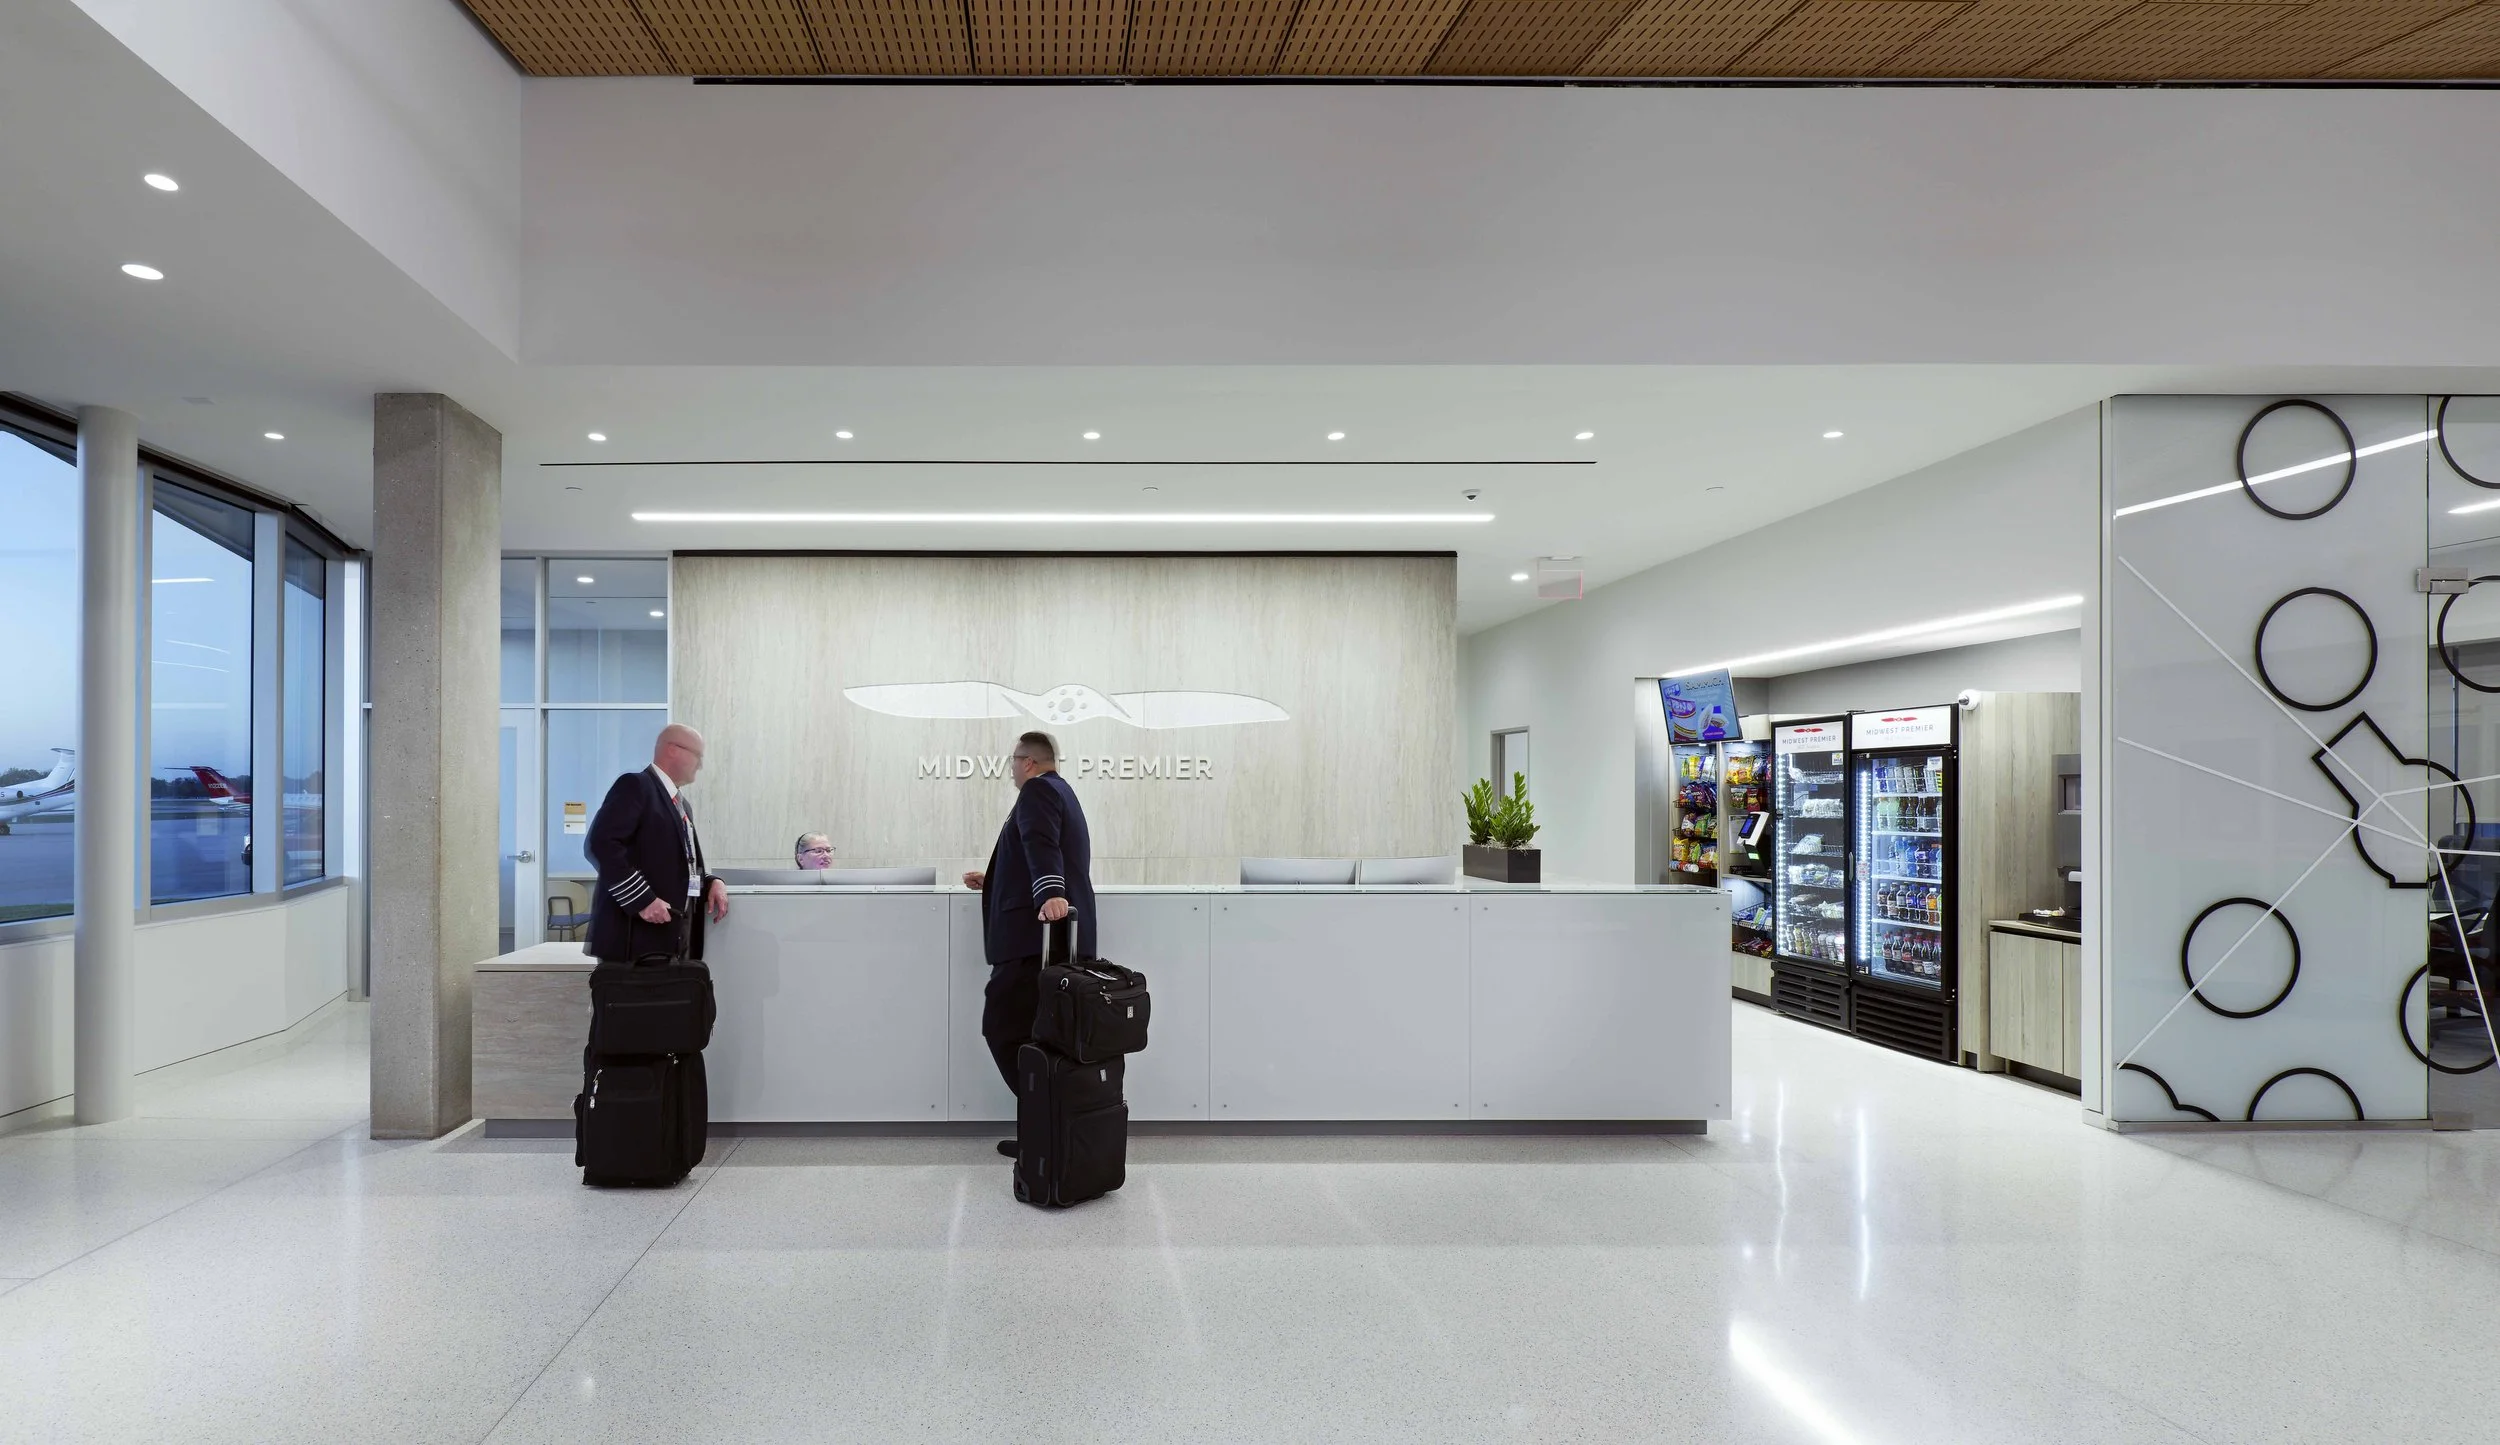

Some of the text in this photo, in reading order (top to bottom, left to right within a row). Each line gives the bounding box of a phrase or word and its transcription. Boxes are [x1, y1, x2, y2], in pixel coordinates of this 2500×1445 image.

[1865, 724, 1934, 736] MIDWEST PREMIER
[1077, 755, 1214, 780] PREMIER
